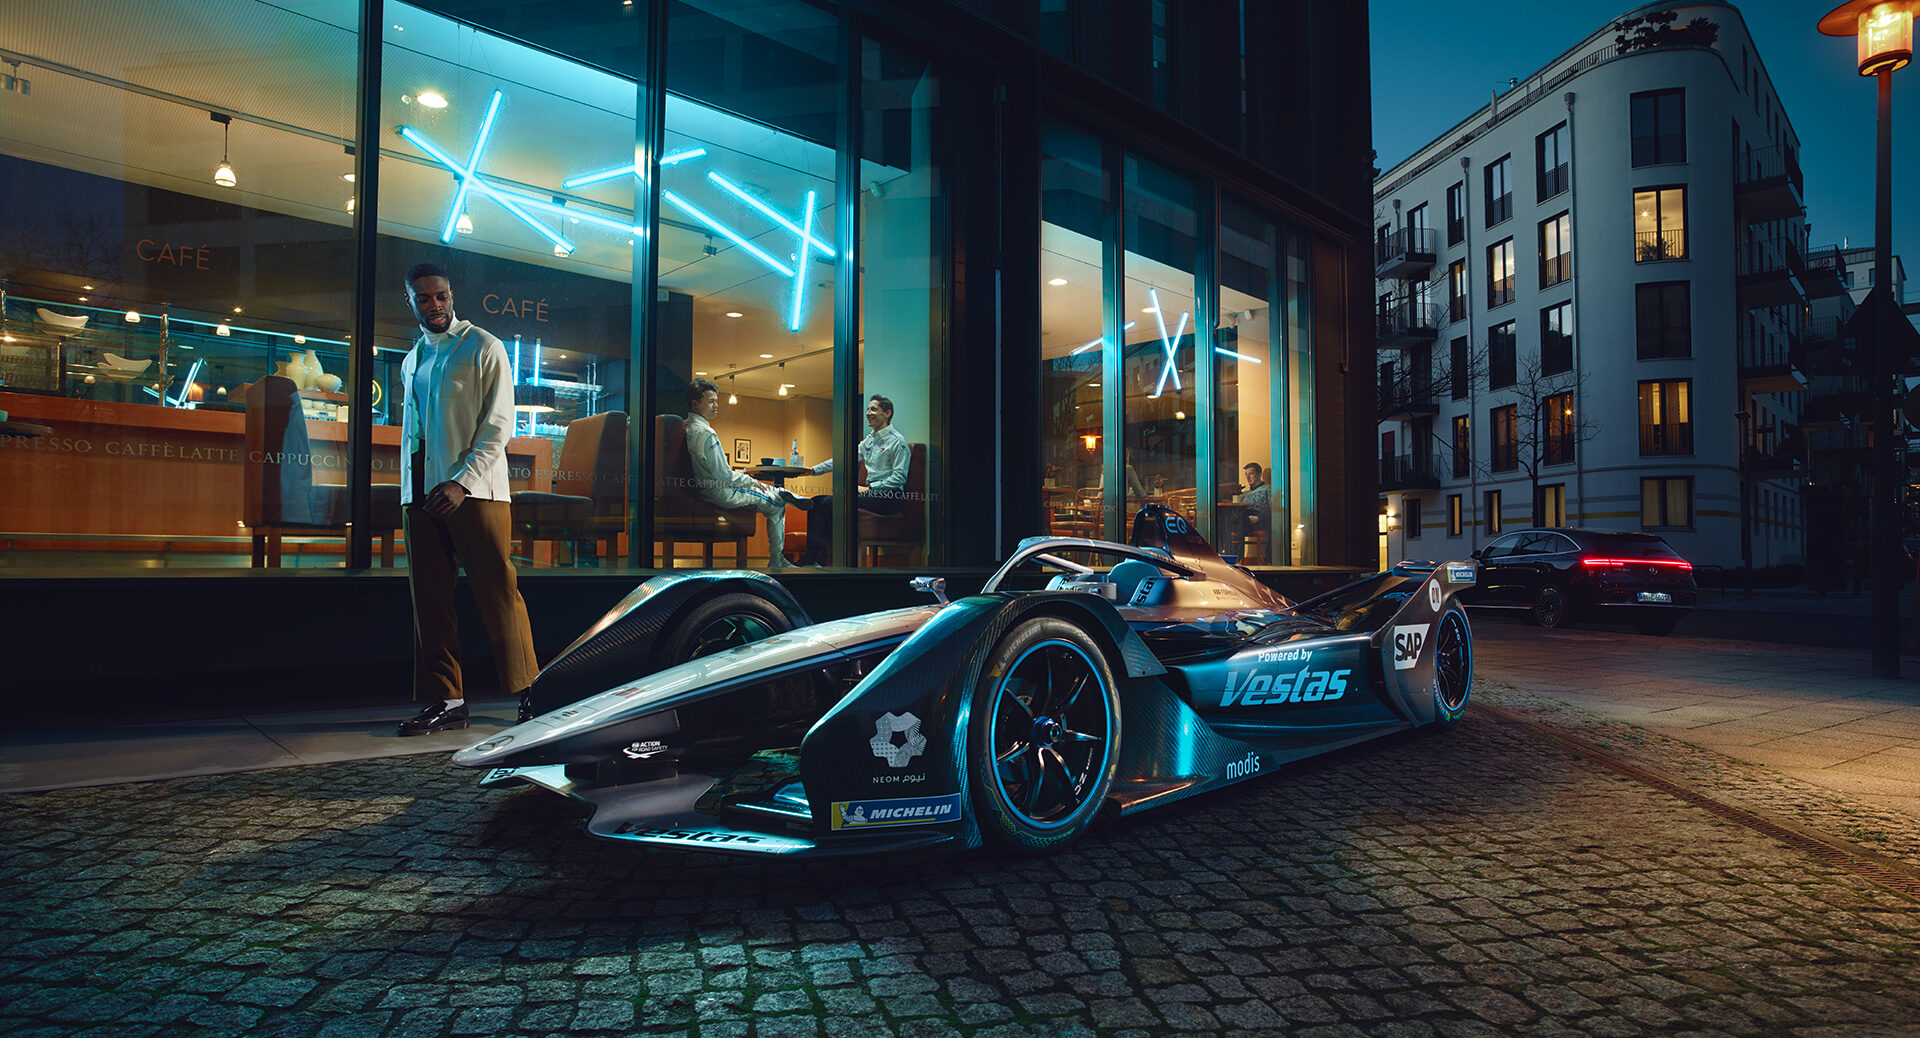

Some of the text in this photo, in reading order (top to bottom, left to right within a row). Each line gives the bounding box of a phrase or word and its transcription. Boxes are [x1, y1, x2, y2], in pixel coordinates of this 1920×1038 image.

[136, 239, 210, 271] CAFÉ
[482, 294, 549, 322] CAFÉ
[179, 446, 241, 462] LATTE
[1165, 517, 1188, 535] EQ
[1258, 648, 1313, 663] Powered by
[1395, 632, 1422, 662] SAP
[1219, 664, 1352, 708] Vestas
[1226, 751, 1260, 780] modis
[872, 775, 900, 784] NEOM
[869, 803, 953, 820] MICHELIN
